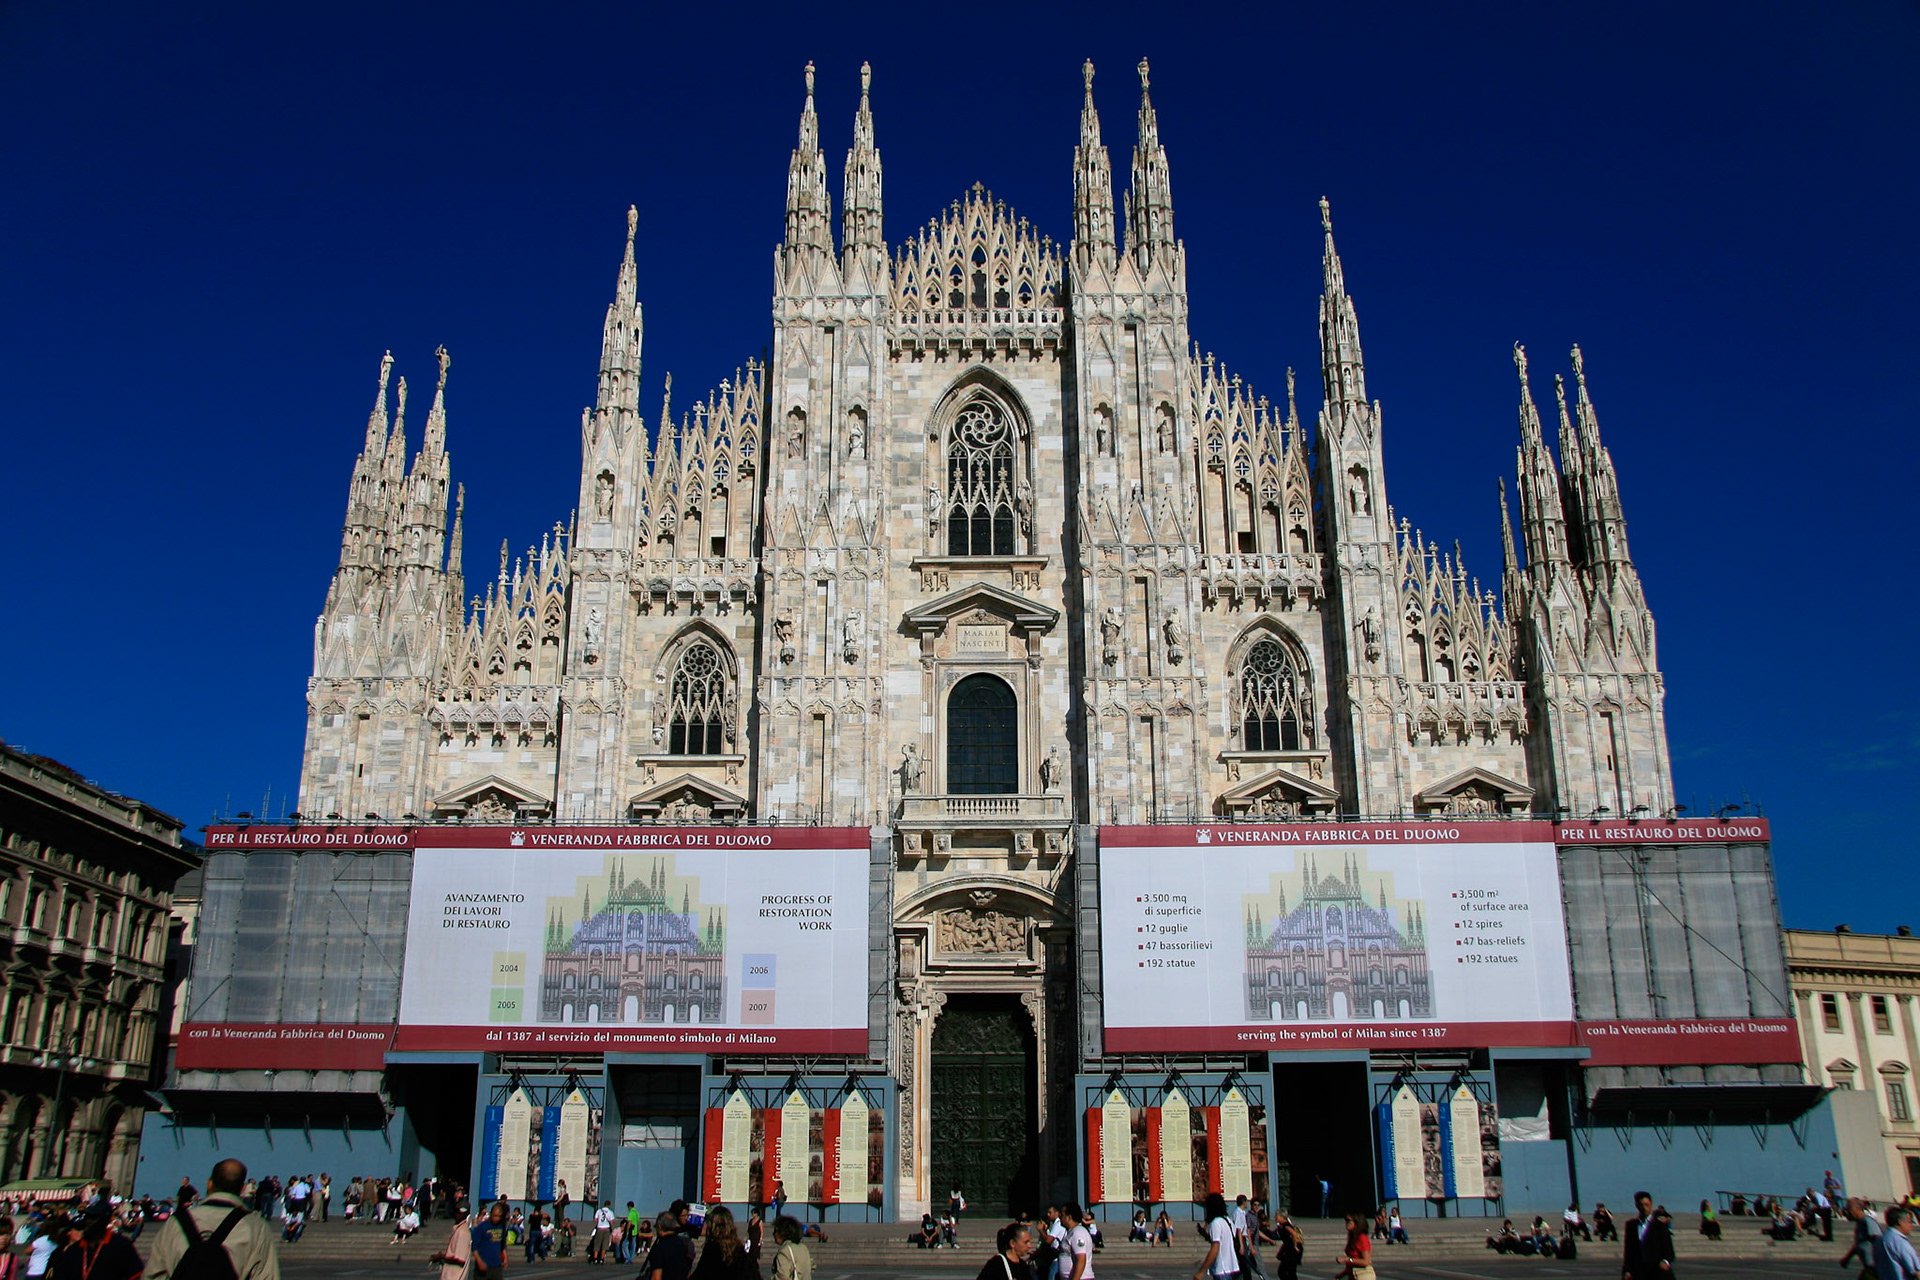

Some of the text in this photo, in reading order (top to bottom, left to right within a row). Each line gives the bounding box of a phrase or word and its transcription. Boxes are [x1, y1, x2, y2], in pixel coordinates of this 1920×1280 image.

[960, 639, 1004, 647] NASCENTI
[212, 833, 408, 845] PER IL RESTAURO DEL DUOMO
[1217, 828, 1460, 842] VENERANDA FABBRICA DEL DUOMO
[1561, 826, 1762, 840] PER IL RESTAURO DEL DUOMO
[531, 834, 772, 846] VENERANDA FABBRICA DEL DUOMO
[444, 893, 525, 903] AVANZAMENTO
[761, 895, 832, 905] PROGRESS OF
[1144, 893, 1187, 905] 3.500 mq
[1459, 889, 1485, 900] 3,500
[443, 906, 502, 916] DEI LAVORI
[1144, 905, 1202, 917] di superficie
[1460, 901, 1529, 912] of surface area
[759, 908, 832, 918] RESTORATION
[442, 919, 511, 929] DI RESTAURO
[798, 921, 832, 931] WORK
[1145, 923, 1188, 935] 12 guglie
[1462, 919, 1503, 931] 12 spires
[1145, 940, 1213, 950] 47 bassorilievi
[1463, 935, 1526, 946] 47 bas-reliefs
[1146, 958, 1196, 968] 192 statue
[1465, 954, 1519, 964] 192 statues
[499, 964, 519, 973] 2004
[749, 966, 769, 975] 2006
[497, 1000, 516, 1009] 2005
[748, 1003, 768, 1011] 2007
[189, 1027, 385, 1040] con la Veneranda Fabbrica del Duomo
[1237, 1027, 1447, 1042] serving the symbol of Milan since 1387
[1586, 1022, 1788, 1036] con la Veneranda Fabbrica del Duomo
[486, 1030, 777, 1044] dal 1387 al servizio del monumento simbolo di Milano
[546, 1111, 554, 1123] 2
[489, 1131, 497, 1162] progress
[547, 1133, 555, 1163] progress
[772, 1136, 781, 1182] facciata
[1157, 1124, 1165, 1190] conservazione
[546, 1165, 553, 1173] in
[831, 1136, 840, 1199] la facciata
[1097, 1125, 1105, 1202] la conservazione
[711, 1151, 722, 1199] la storia
